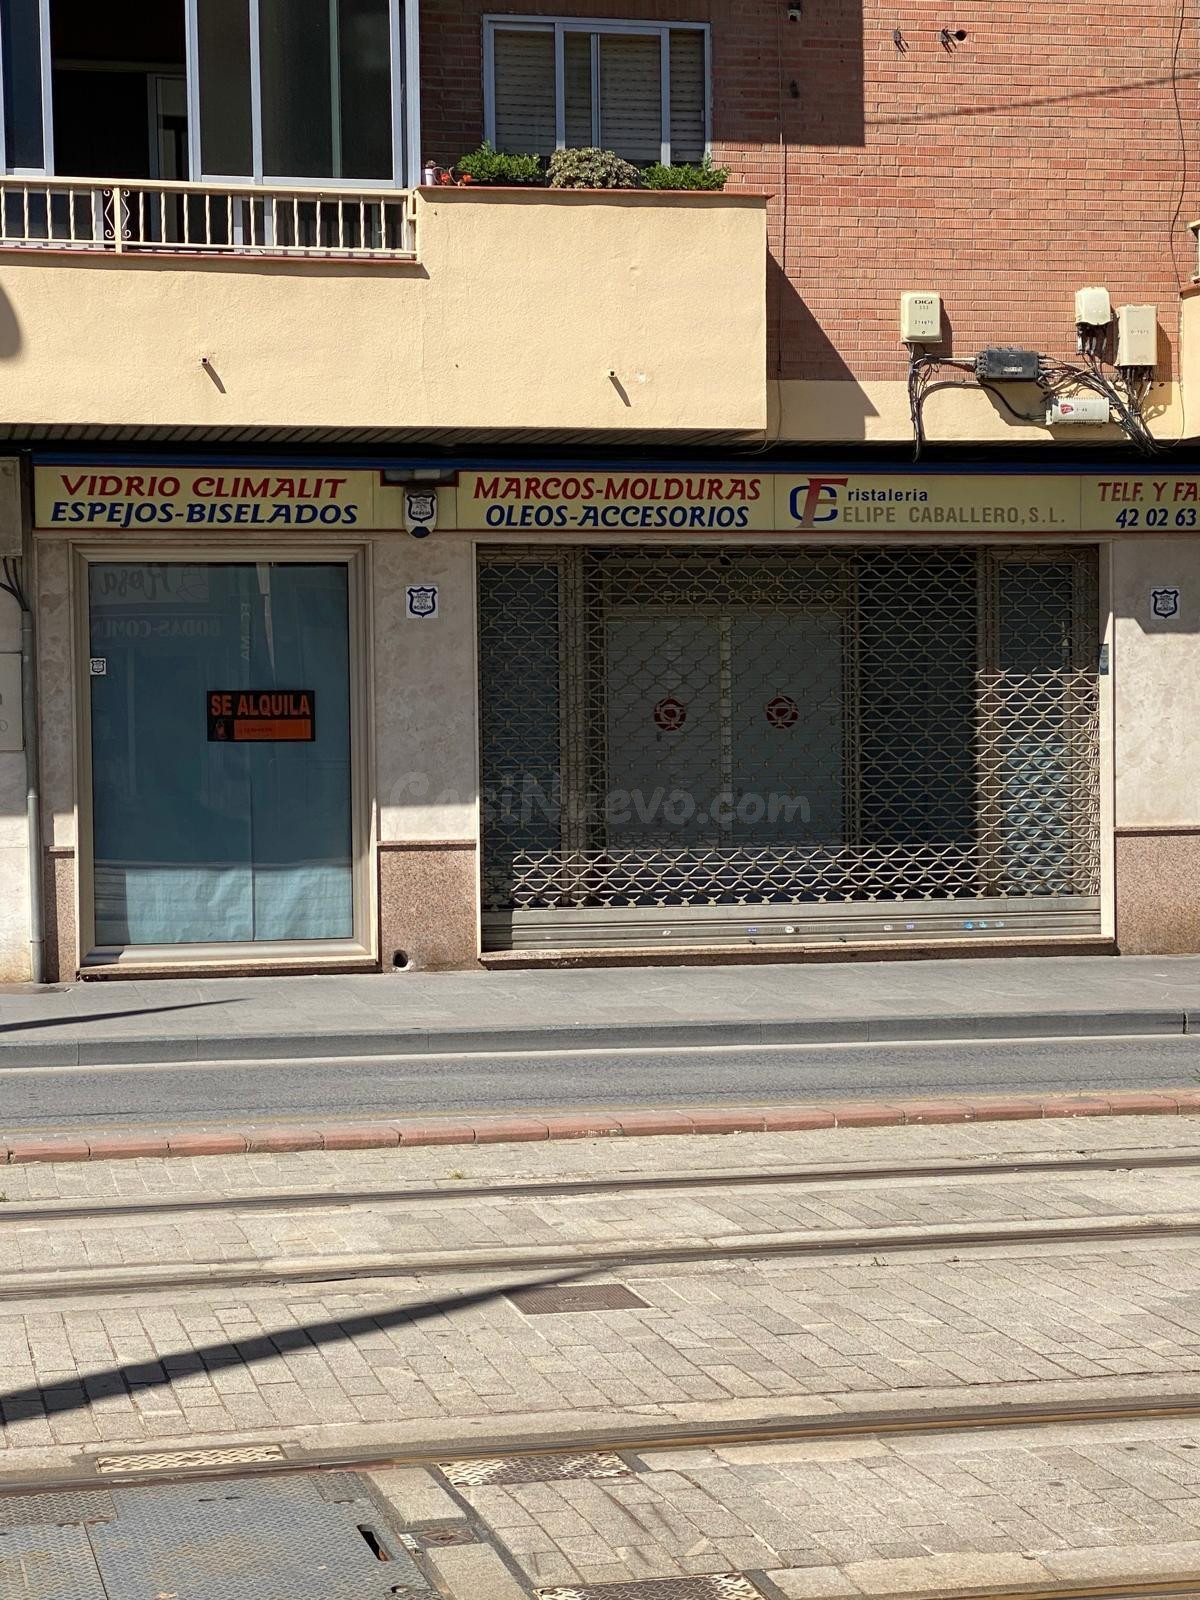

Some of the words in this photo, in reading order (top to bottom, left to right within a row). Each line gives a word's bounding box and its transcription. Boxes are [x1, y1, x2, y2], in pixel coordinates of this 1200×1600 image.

[61, 475, 181, 497] VIDRIO
[192, 477, 348, 499] CLIMALIT
[473, 476, 761, 501] MARCOS-MOLDURAS
[1097, 481, 1144, 502] TELF.
[1152, 481, 1169, 502] Y
[1173, 481, 1200, 502] FA
[51, 502, 358, 528] ESPEJOS-BISELADOS
[485, 504, 749, 528] OLEOS-ACCESORIOS
[1115, 508, 1140, 529] 42
[1146, 508, 1169, 527] 02
[1175, 508, 1197, 527] 63
[210, 694, 233, 717] SE
[237, 694, 311, 717] ALQUILA
